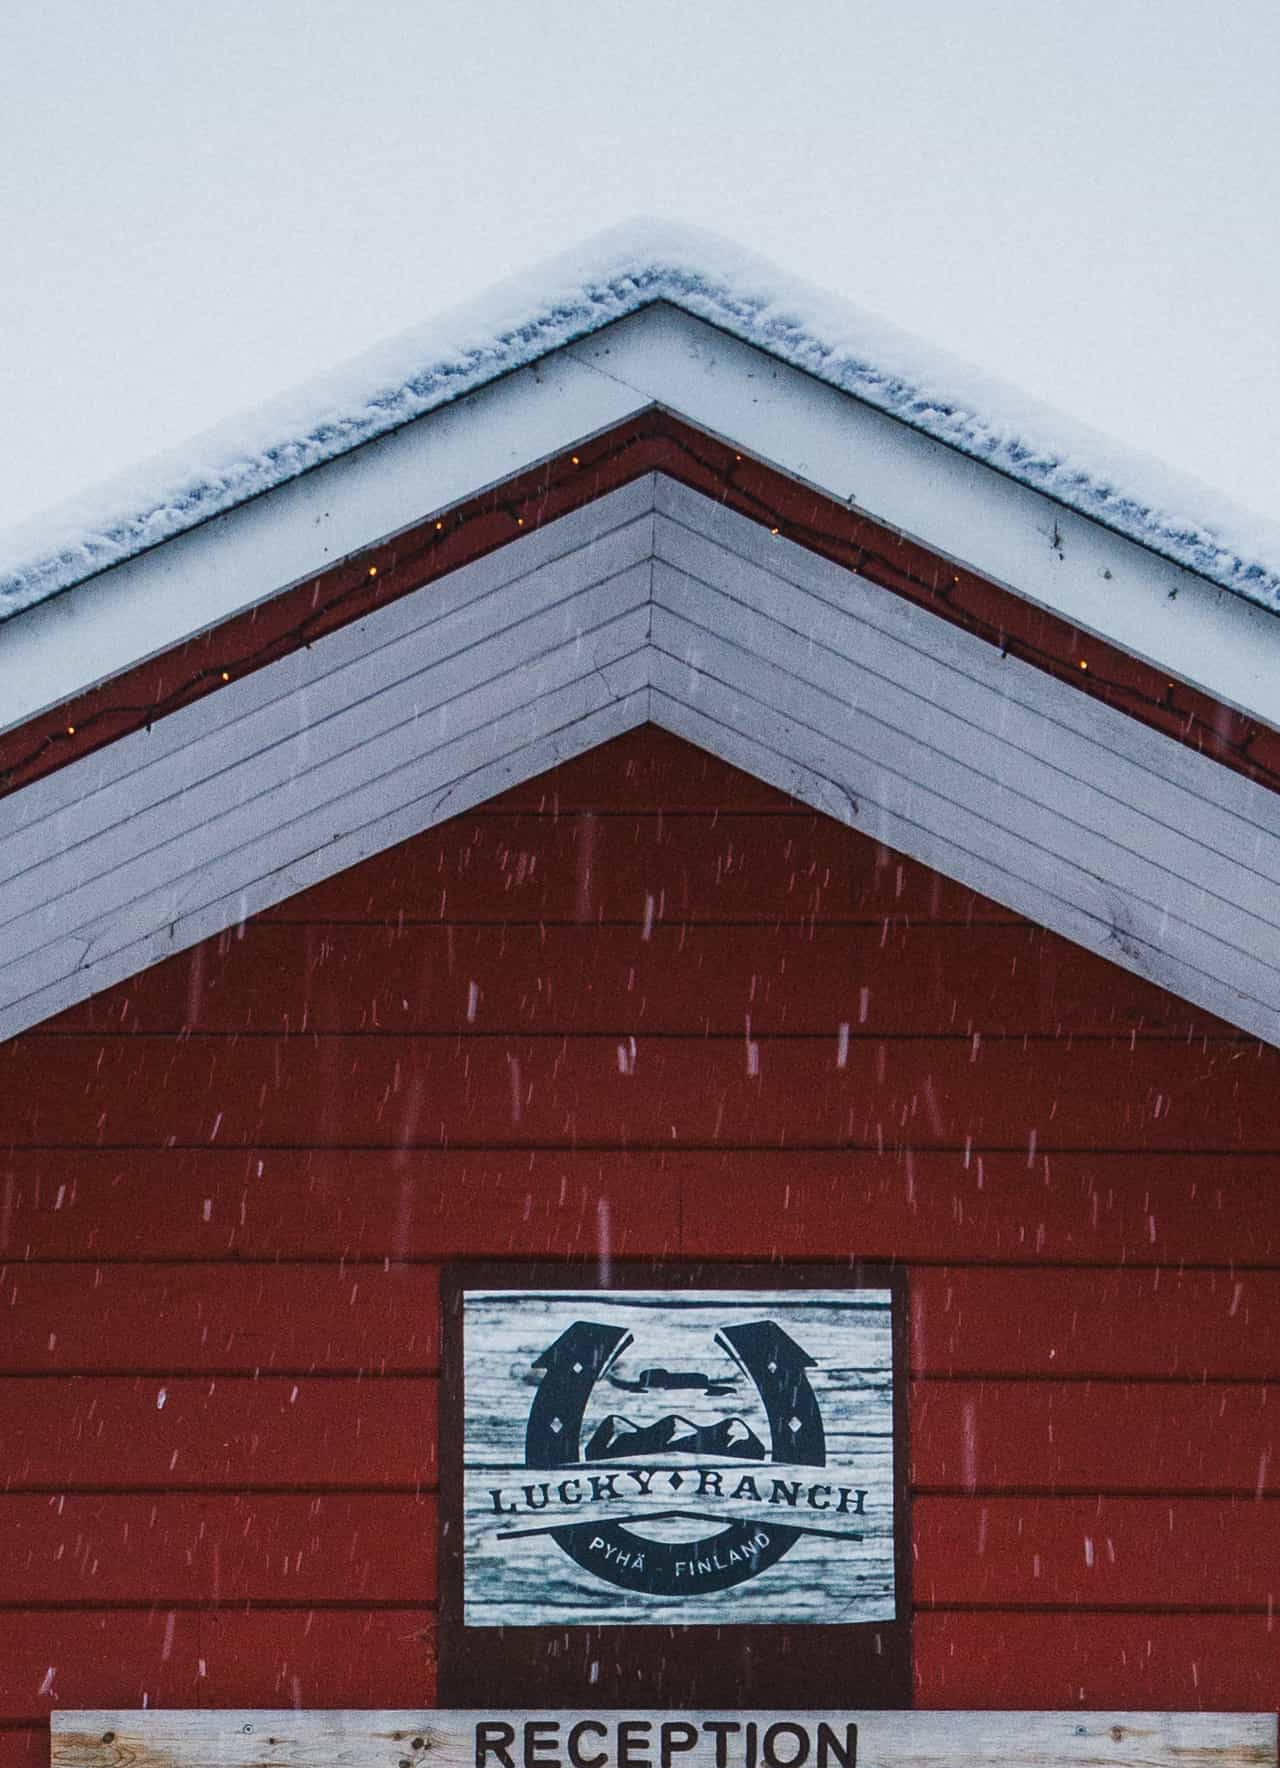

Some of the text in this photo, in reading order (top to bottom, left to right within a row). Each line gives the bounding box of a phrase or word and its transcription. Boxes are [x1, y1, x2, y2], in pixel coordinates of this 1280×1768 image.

[489, 1470, 869, 1514] LUCKY RANCH
[588, 1532, 771, 1577] PYHÄ FINLAND
